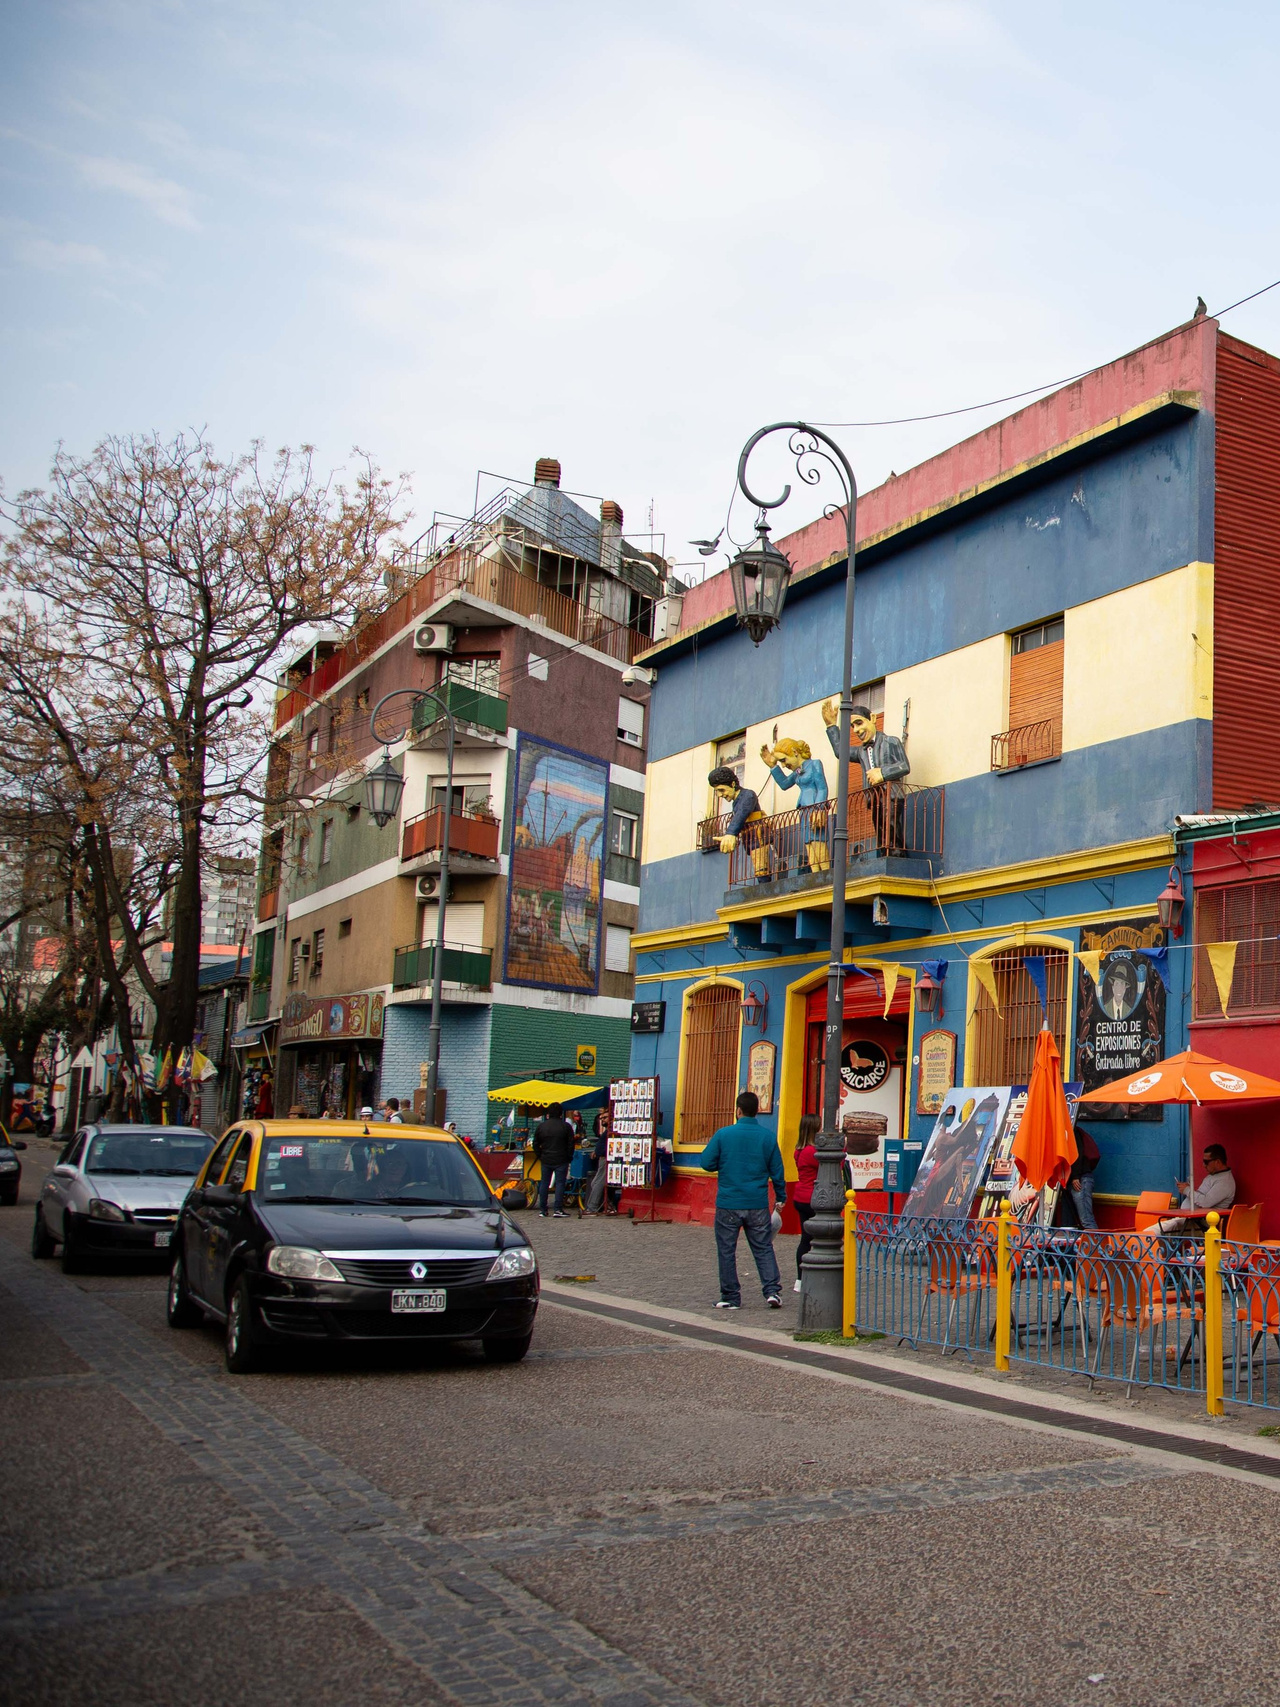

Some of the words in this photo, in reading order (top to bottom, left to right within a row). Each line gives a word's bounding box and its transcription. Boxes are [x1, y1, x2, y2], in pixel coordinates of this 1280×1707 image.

[1101, 929, 1142, 951] CAMINITO
[299, 1009, 323, 1036] TANGO
[1096, 1021, 1128, 1034] CENTRO
[1130, 1021, 1141, 1032] DE
[1096, 1035, 1141, 1051] EXPOSICIONES
[1096, 1053, 1124, 1070] Entrada
[1125, 1053, 1141, 1069] libre
[841, 1061, 885, 1088] BALCARCE
[283, 1146, 303, 1156] LIBRE
[394, 1295, 416, 1308] JKN
[423, 1295, 444, 1308] 840
